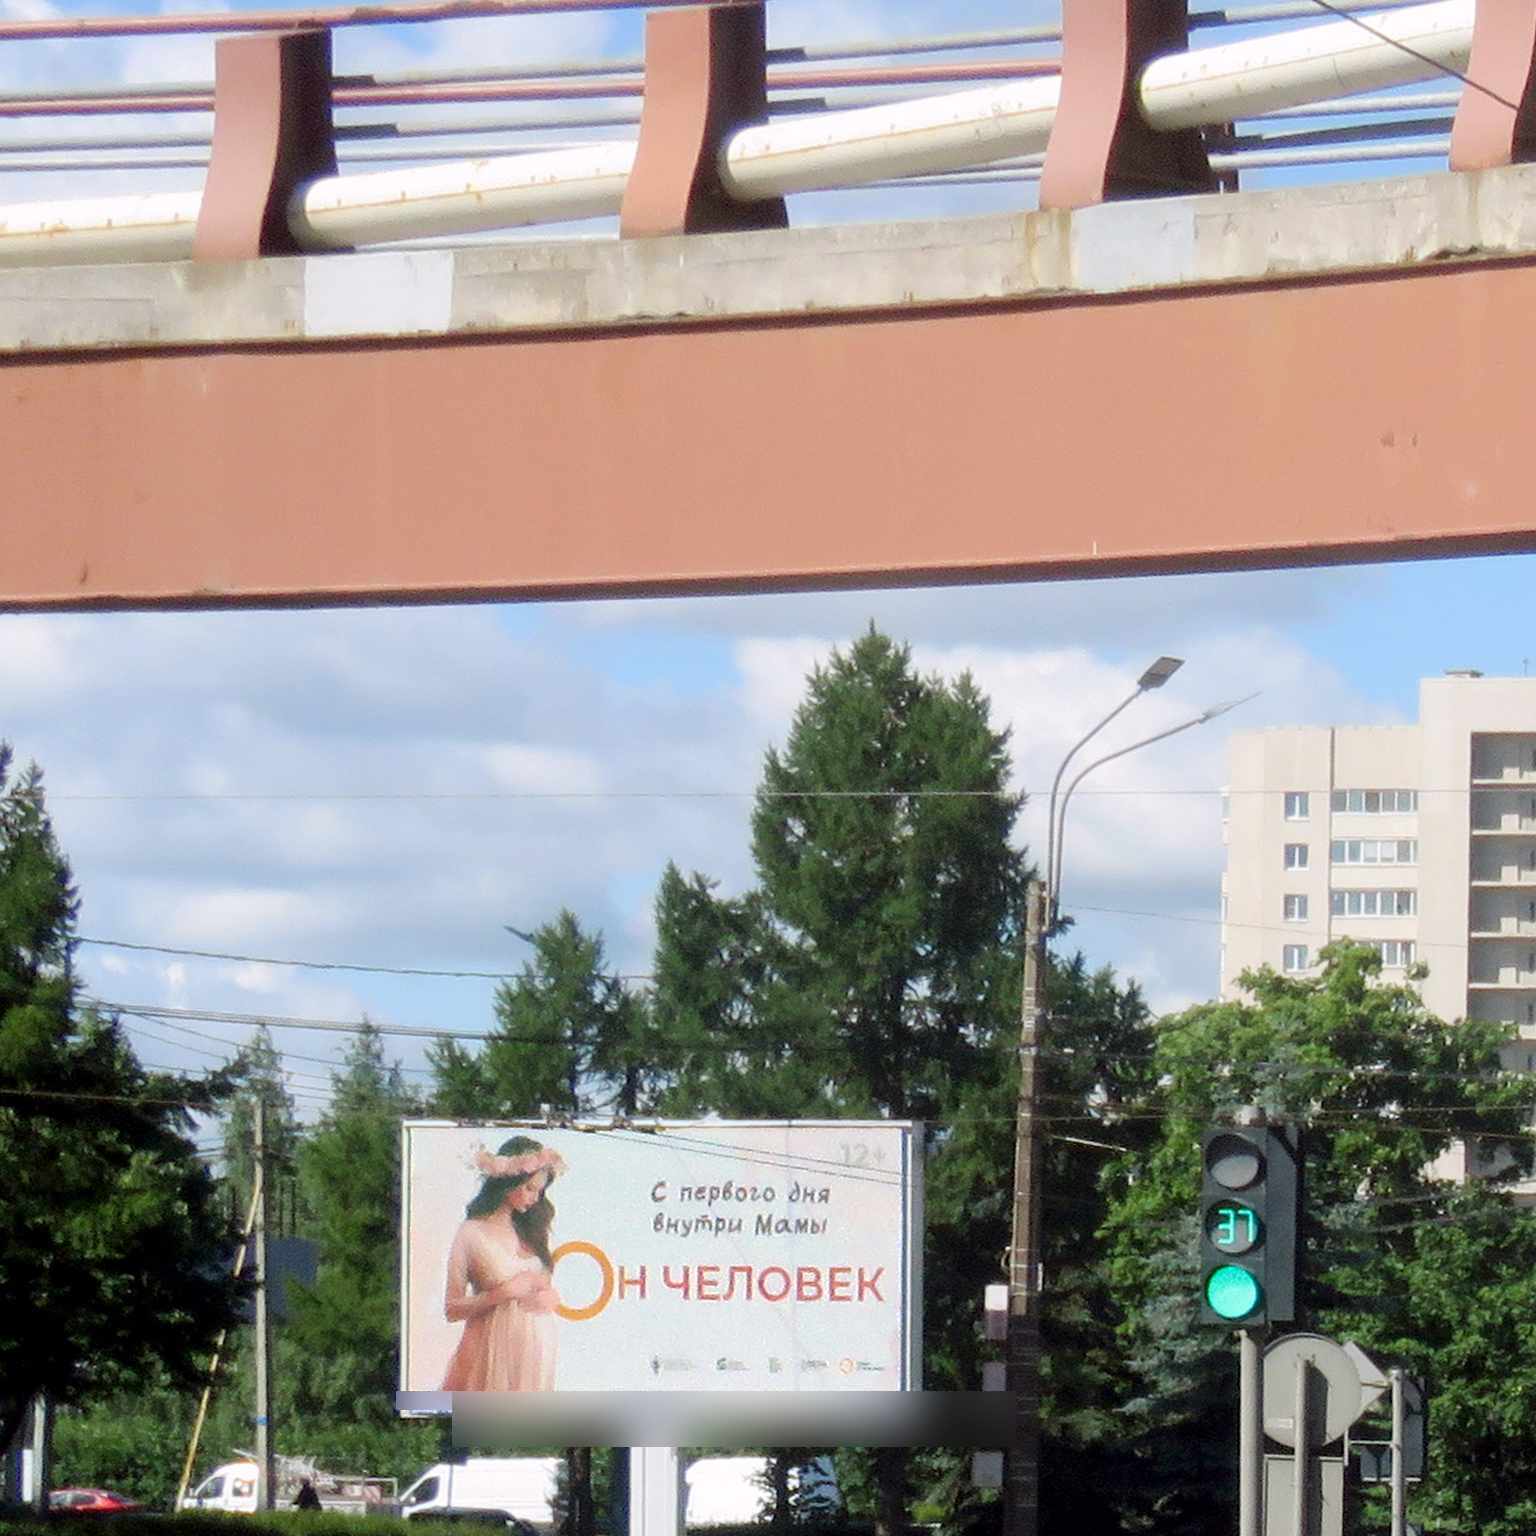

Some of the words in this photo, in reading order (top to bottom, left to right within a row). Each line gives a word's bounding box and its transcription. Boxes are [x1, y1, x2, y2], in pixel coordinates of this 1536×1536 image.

[651, 1180, 667, 1203] С
[679, 1180, 776, 1207] первого
[787, 1181, 831, 1205] дня
[652, 1211, 743, 1239] внутри
[754, 1213, 828, 1236] Мамы
[1218, 1208, 1254, 1244] 37
[662, 1265, 884, 1302] ЧЕЛОВЕК
